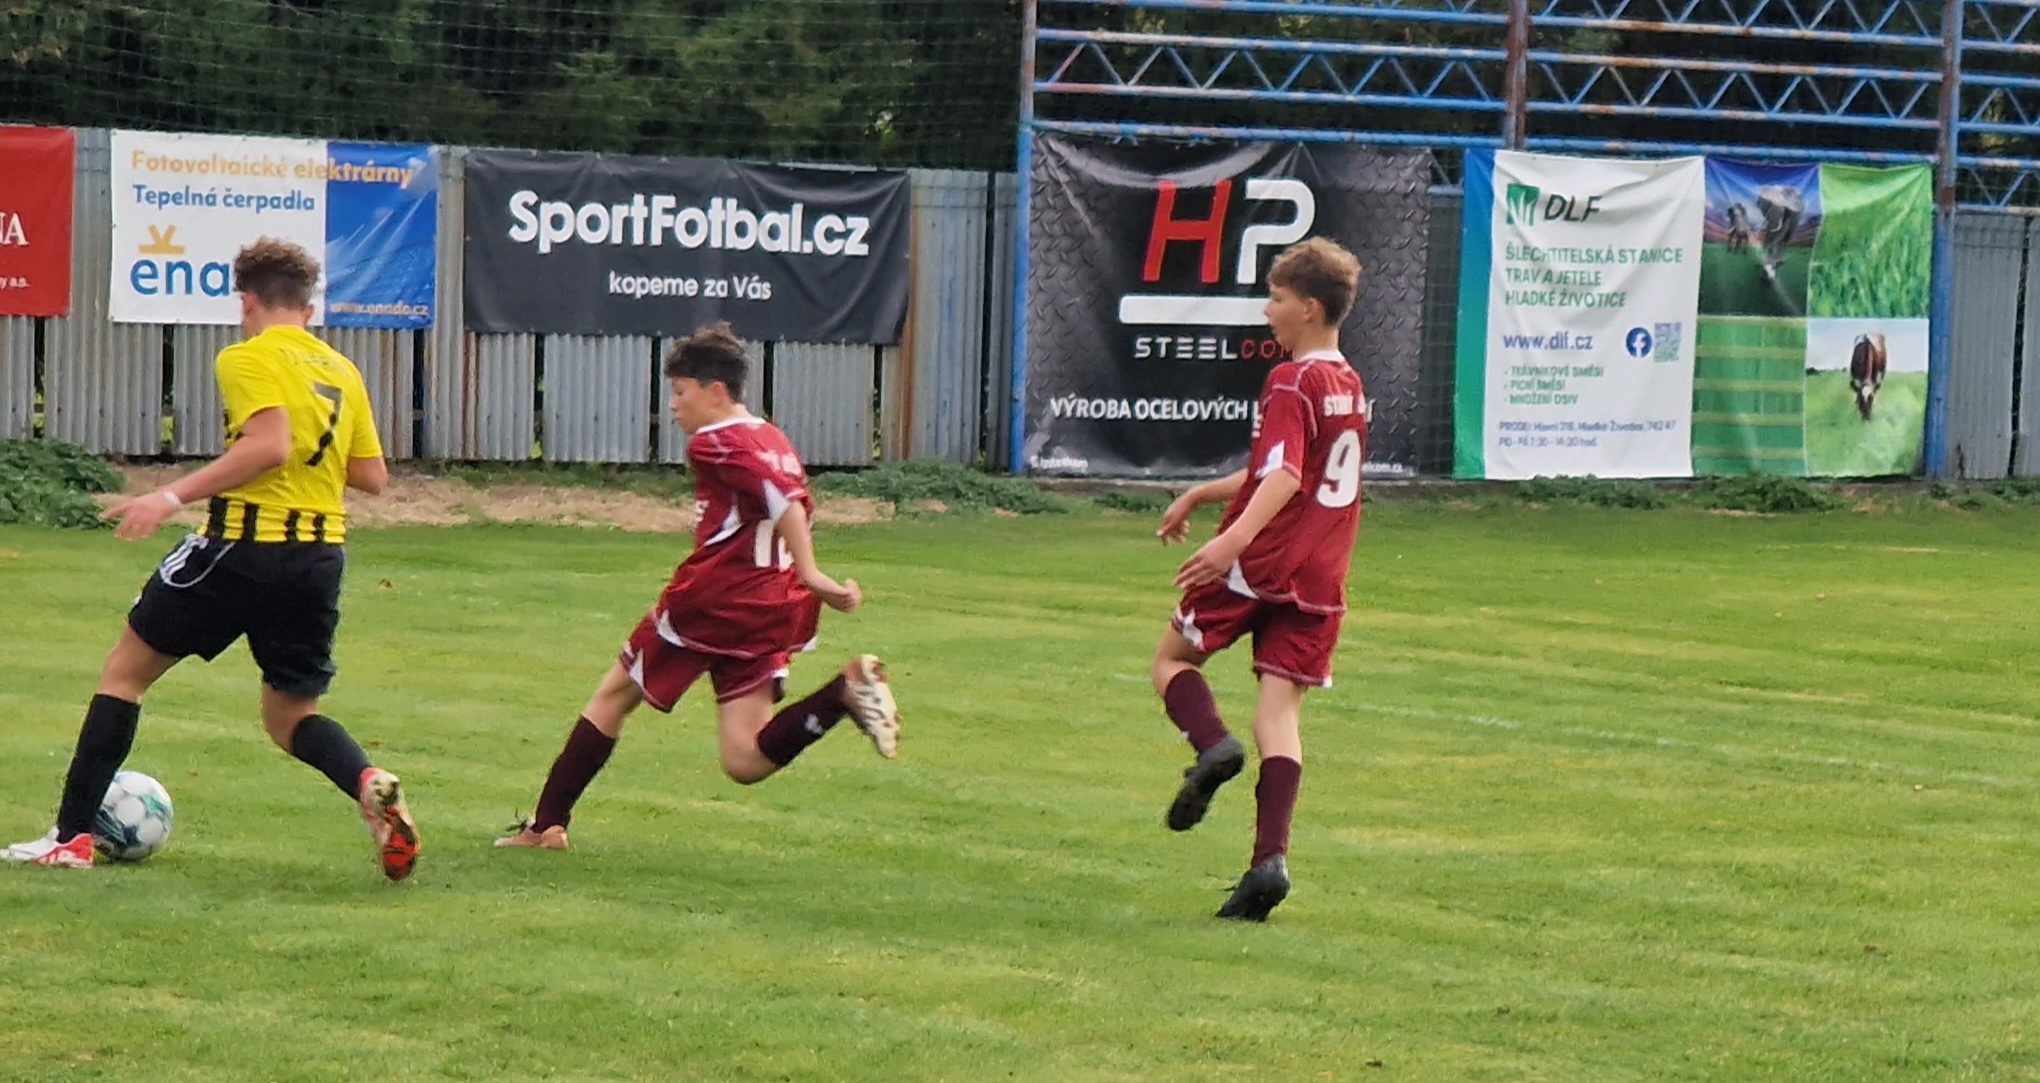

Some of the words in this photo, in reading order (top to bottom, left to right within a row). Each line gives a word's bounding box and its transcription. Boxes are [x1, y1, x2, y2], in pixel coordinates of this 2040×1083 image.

[132, 150, 288, 178] Fotovoltaické
[294, 157, 413, 189] elektrárny
[133, 184, 217, 210] Tepelná
[223, 186, 315, 214] čerpadla
[1543, 193, 1602, 223] DLF
[508, 190, 870, 255] SportFotbal.cz
[1618, 247, 1684, 264] STANICE
[130, 258, 231, 297] ena
[609, 271, 699, 299] kopeme
[704, 278, 728, 298] za
[732, 275, 772, 300] Vás
[1505, 267, 1539, 283] TRAV
[1542, 268, 1553, 284] A
[1555, 270, 1602, 286] JETELE
[1505, 290, 1556, 307] HLADKÉ
[1558, 291, 1627, 308] ŽIVOTICE
[1503, 331, 1594, 350] www.dlf.cz
[1050, 392, 1132, 419] VÝROBA
[1134, 395, 1249, 421] OCELOVÝCH
[305, 381, 342, 467] 7
[1317, 430, 1361, 508] 9
